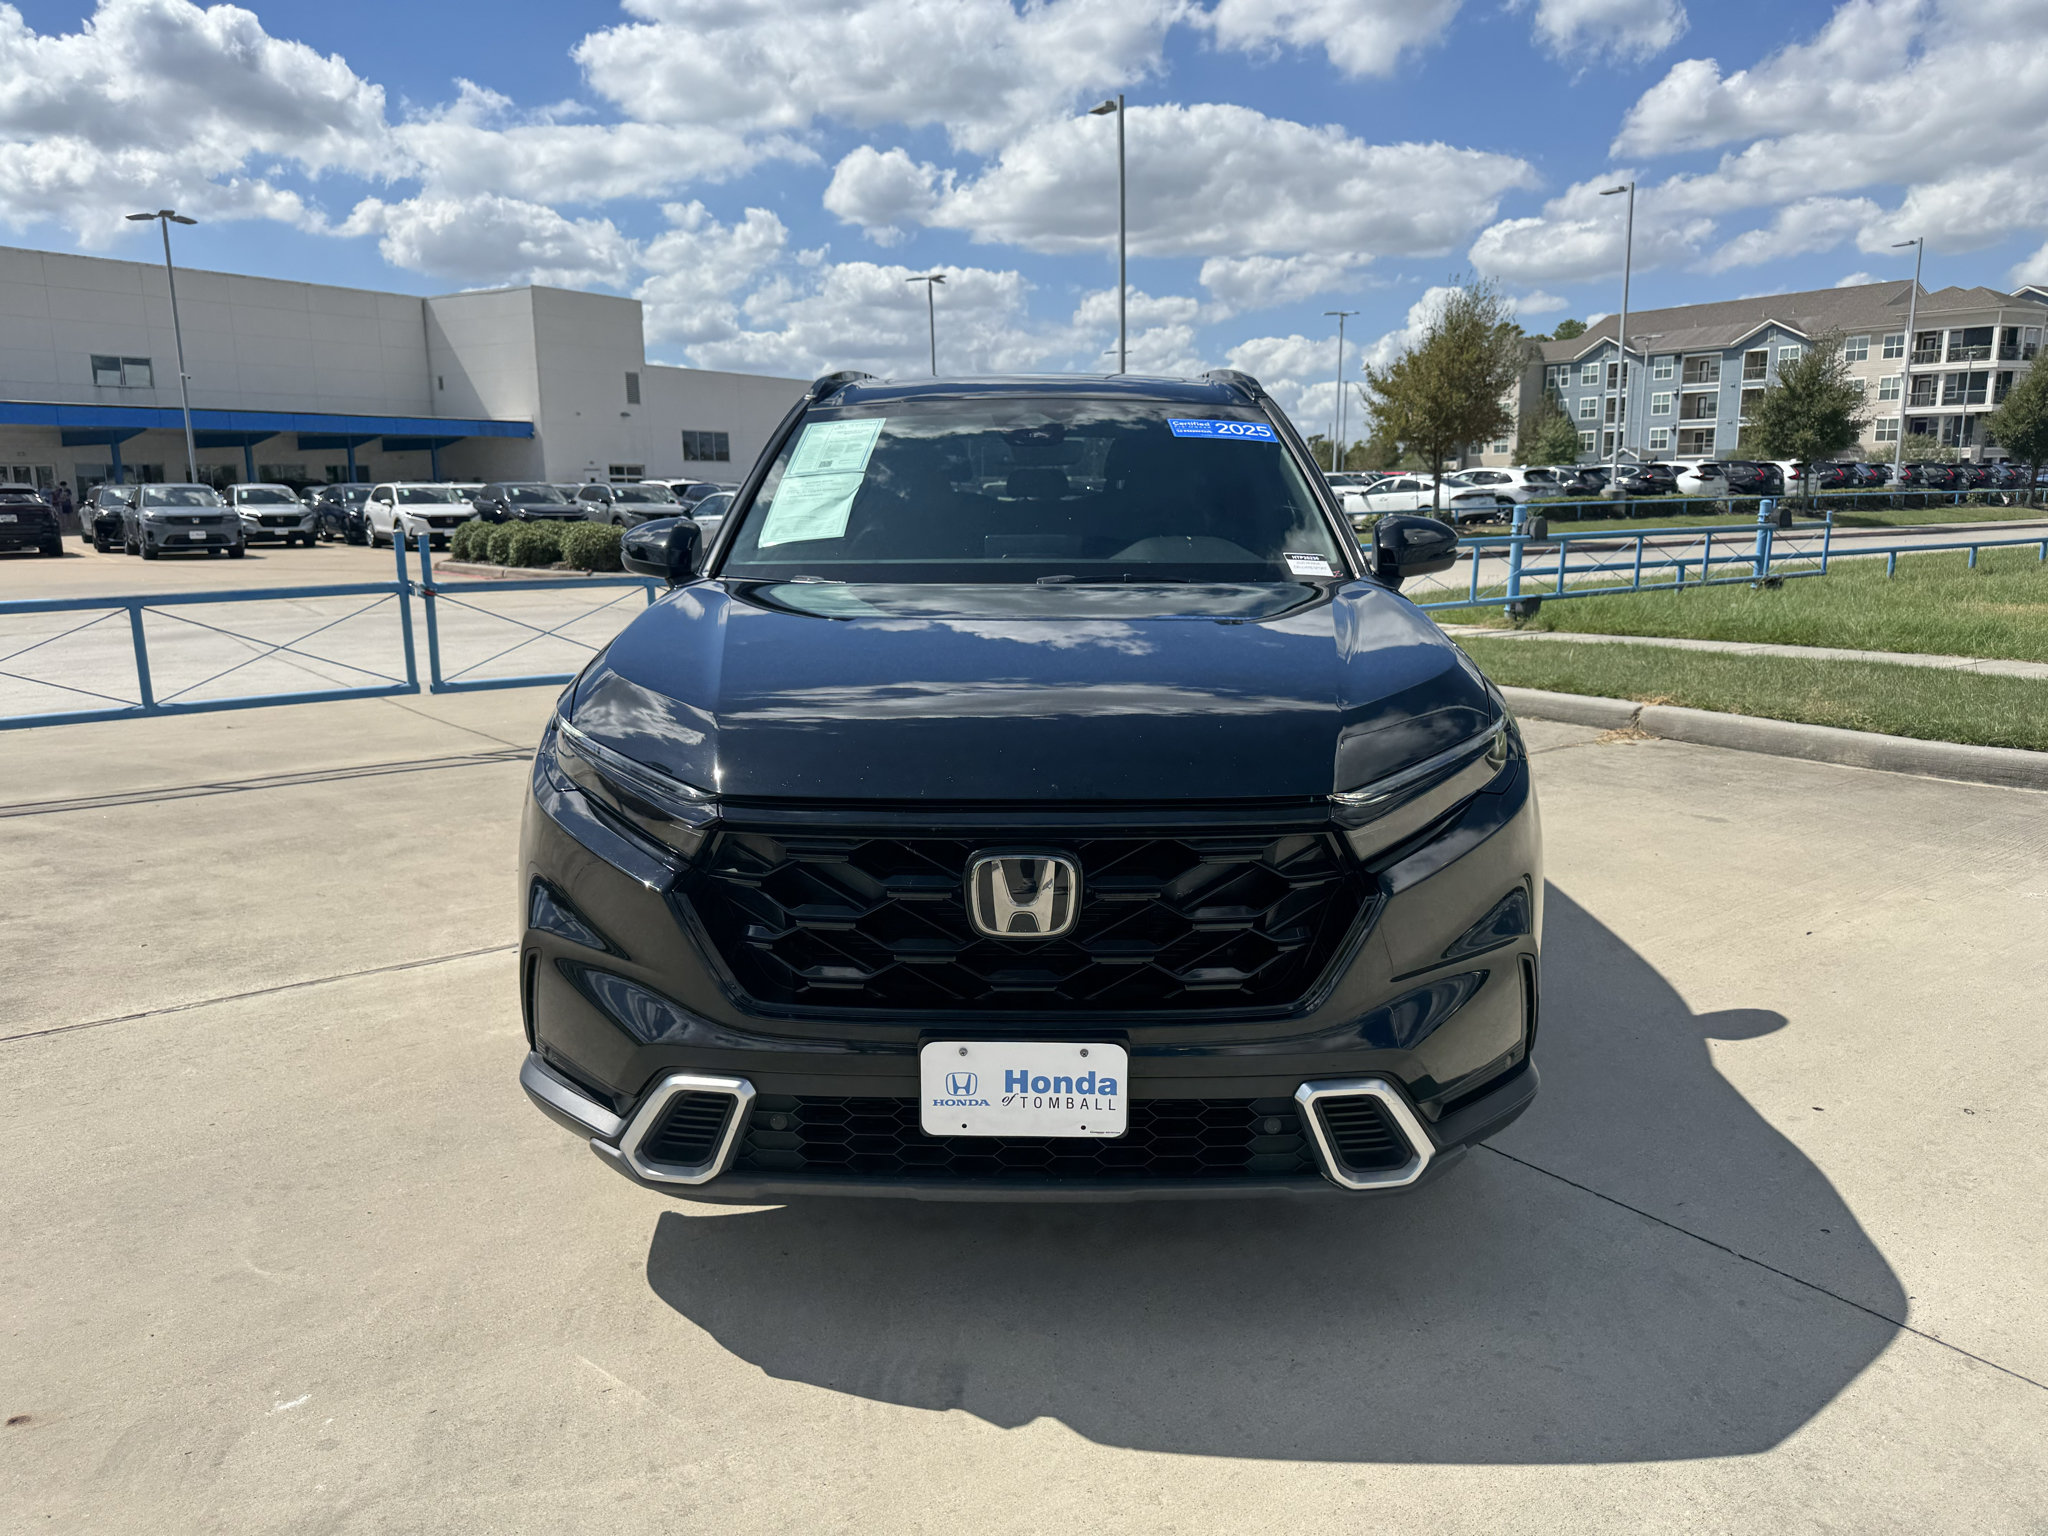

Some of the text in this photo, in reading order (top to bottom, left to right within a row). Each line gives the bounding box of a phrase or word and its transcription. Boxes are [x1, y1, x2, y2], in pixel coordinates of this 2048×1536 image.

[1215, 422, 1271, 437] 2025
[1004, 1069, 1118, 1096] Honda
[932, 1099, 991, 1107] HONDA
[1001, 1093, 1116, 1111] of TOMBALL
